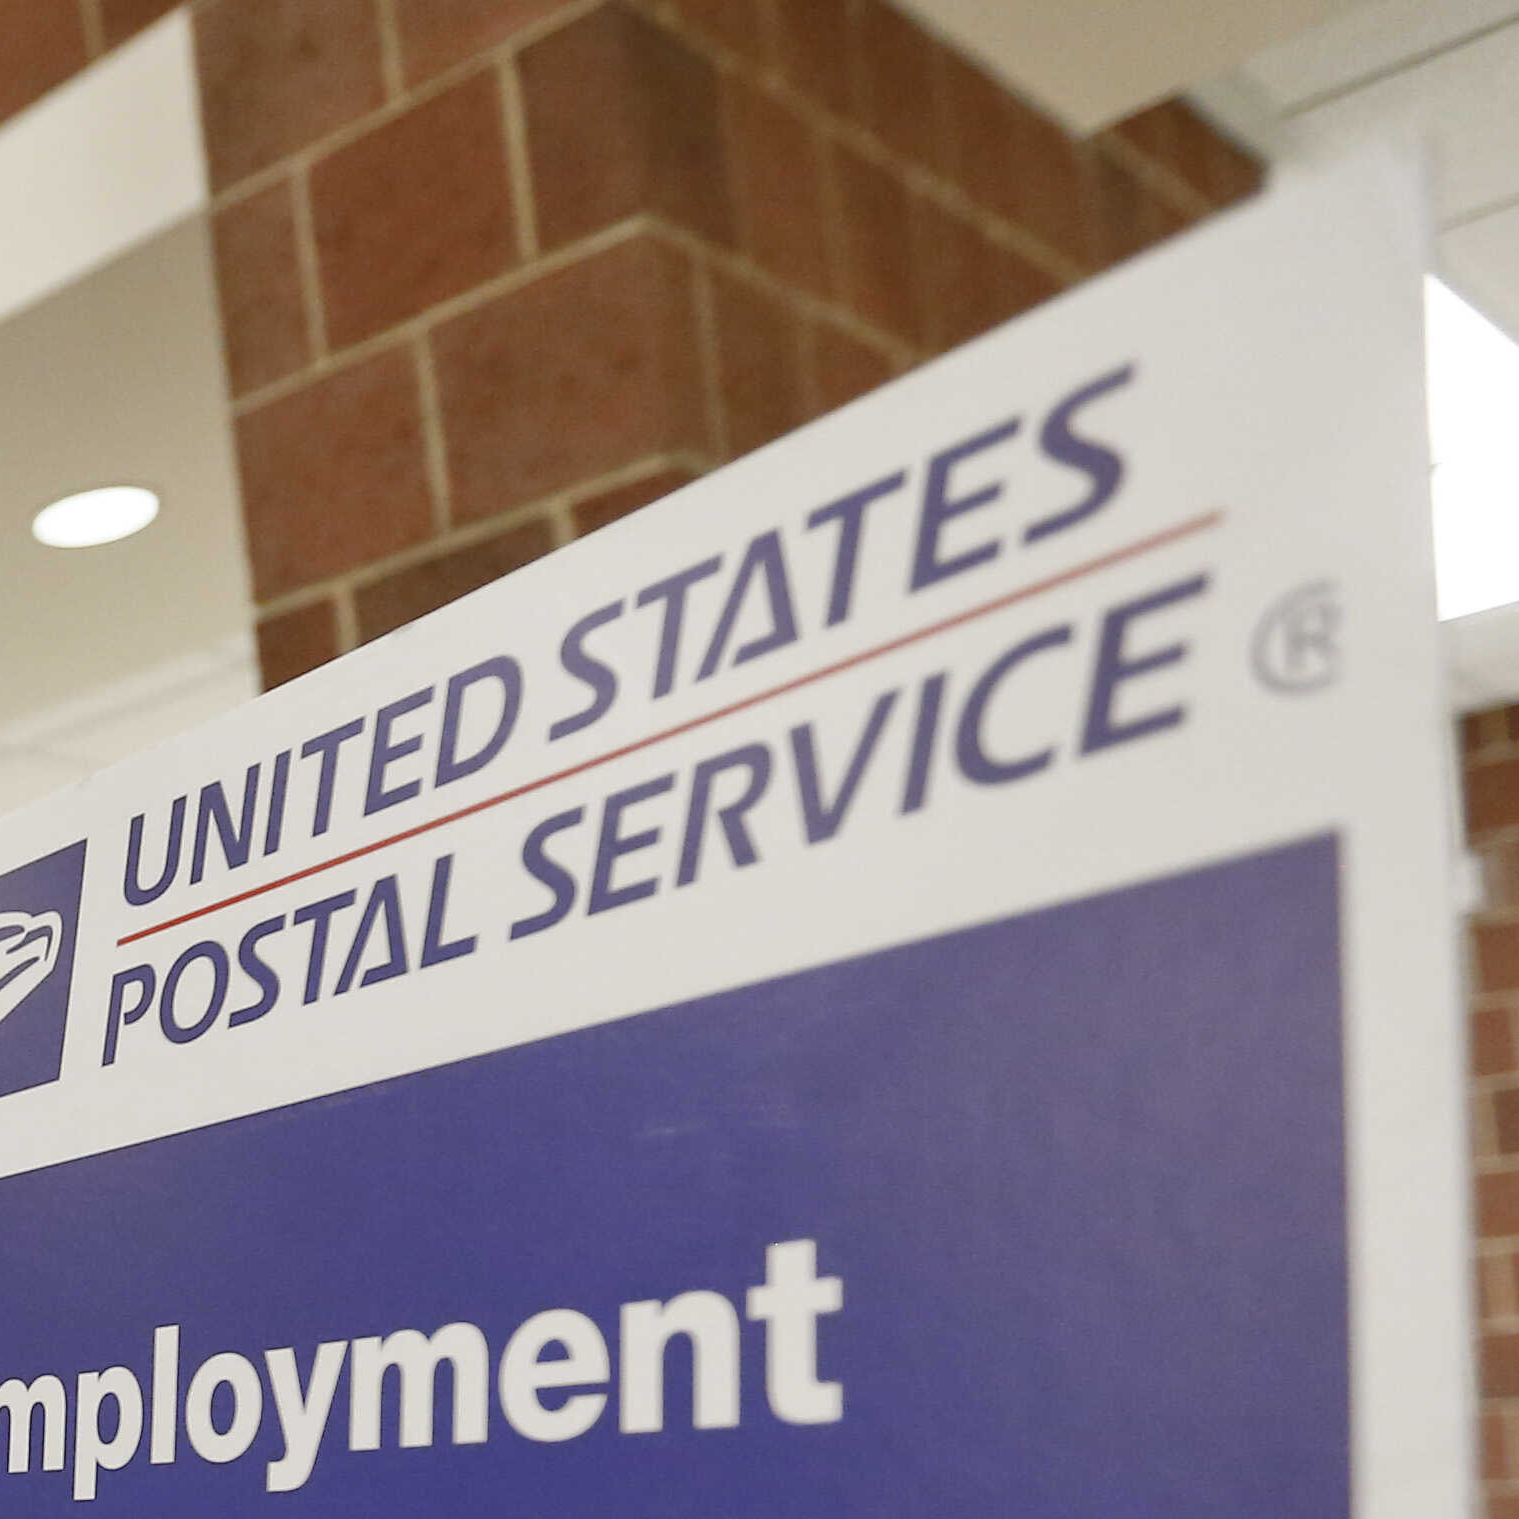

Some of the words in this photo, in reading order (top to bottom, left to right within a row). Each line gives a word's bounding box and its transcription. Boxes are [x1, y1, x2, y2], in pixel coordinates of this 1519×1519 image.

[100, 853, 479, 1068] POSTAL
[511, 572, 1213, 941] SERVICE
[120, 653, 521, 908] UNITED
[547, 362, 1136, 742] STATES
